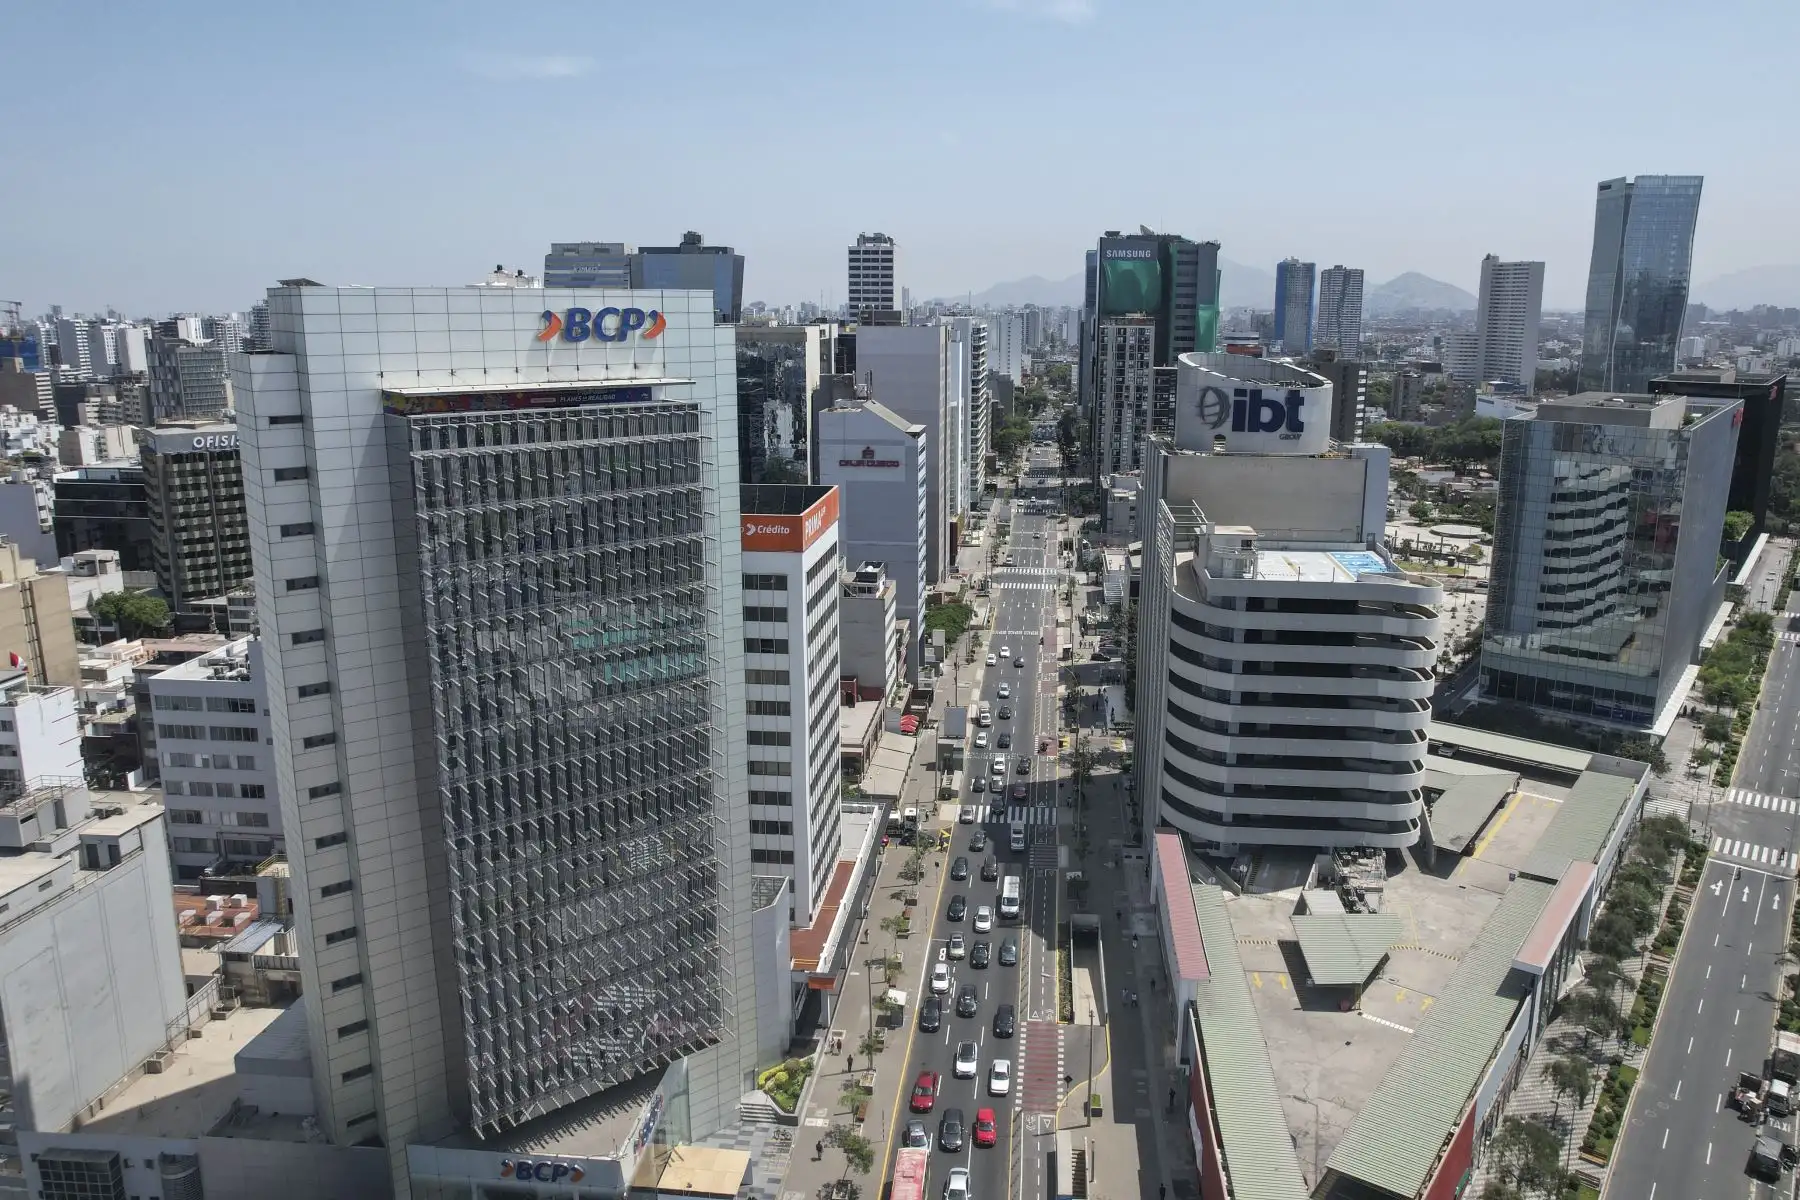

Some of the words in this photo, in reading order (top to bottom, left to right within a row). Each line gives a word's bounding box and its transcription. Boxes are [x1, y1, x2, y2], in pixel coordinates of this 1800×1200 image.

[1106, 249, 1151, 258] SAMSUNG
[563, 307, 646, 343] BCP
[1231, 388, 1305, 433] ibt
[757, 524, 790, 534] Crédito
[805, 511, 821, 540] PRIMA
[1769, 1117, 1791, 1133] TAXI
[516, 1159, 569, 1182] BCP
